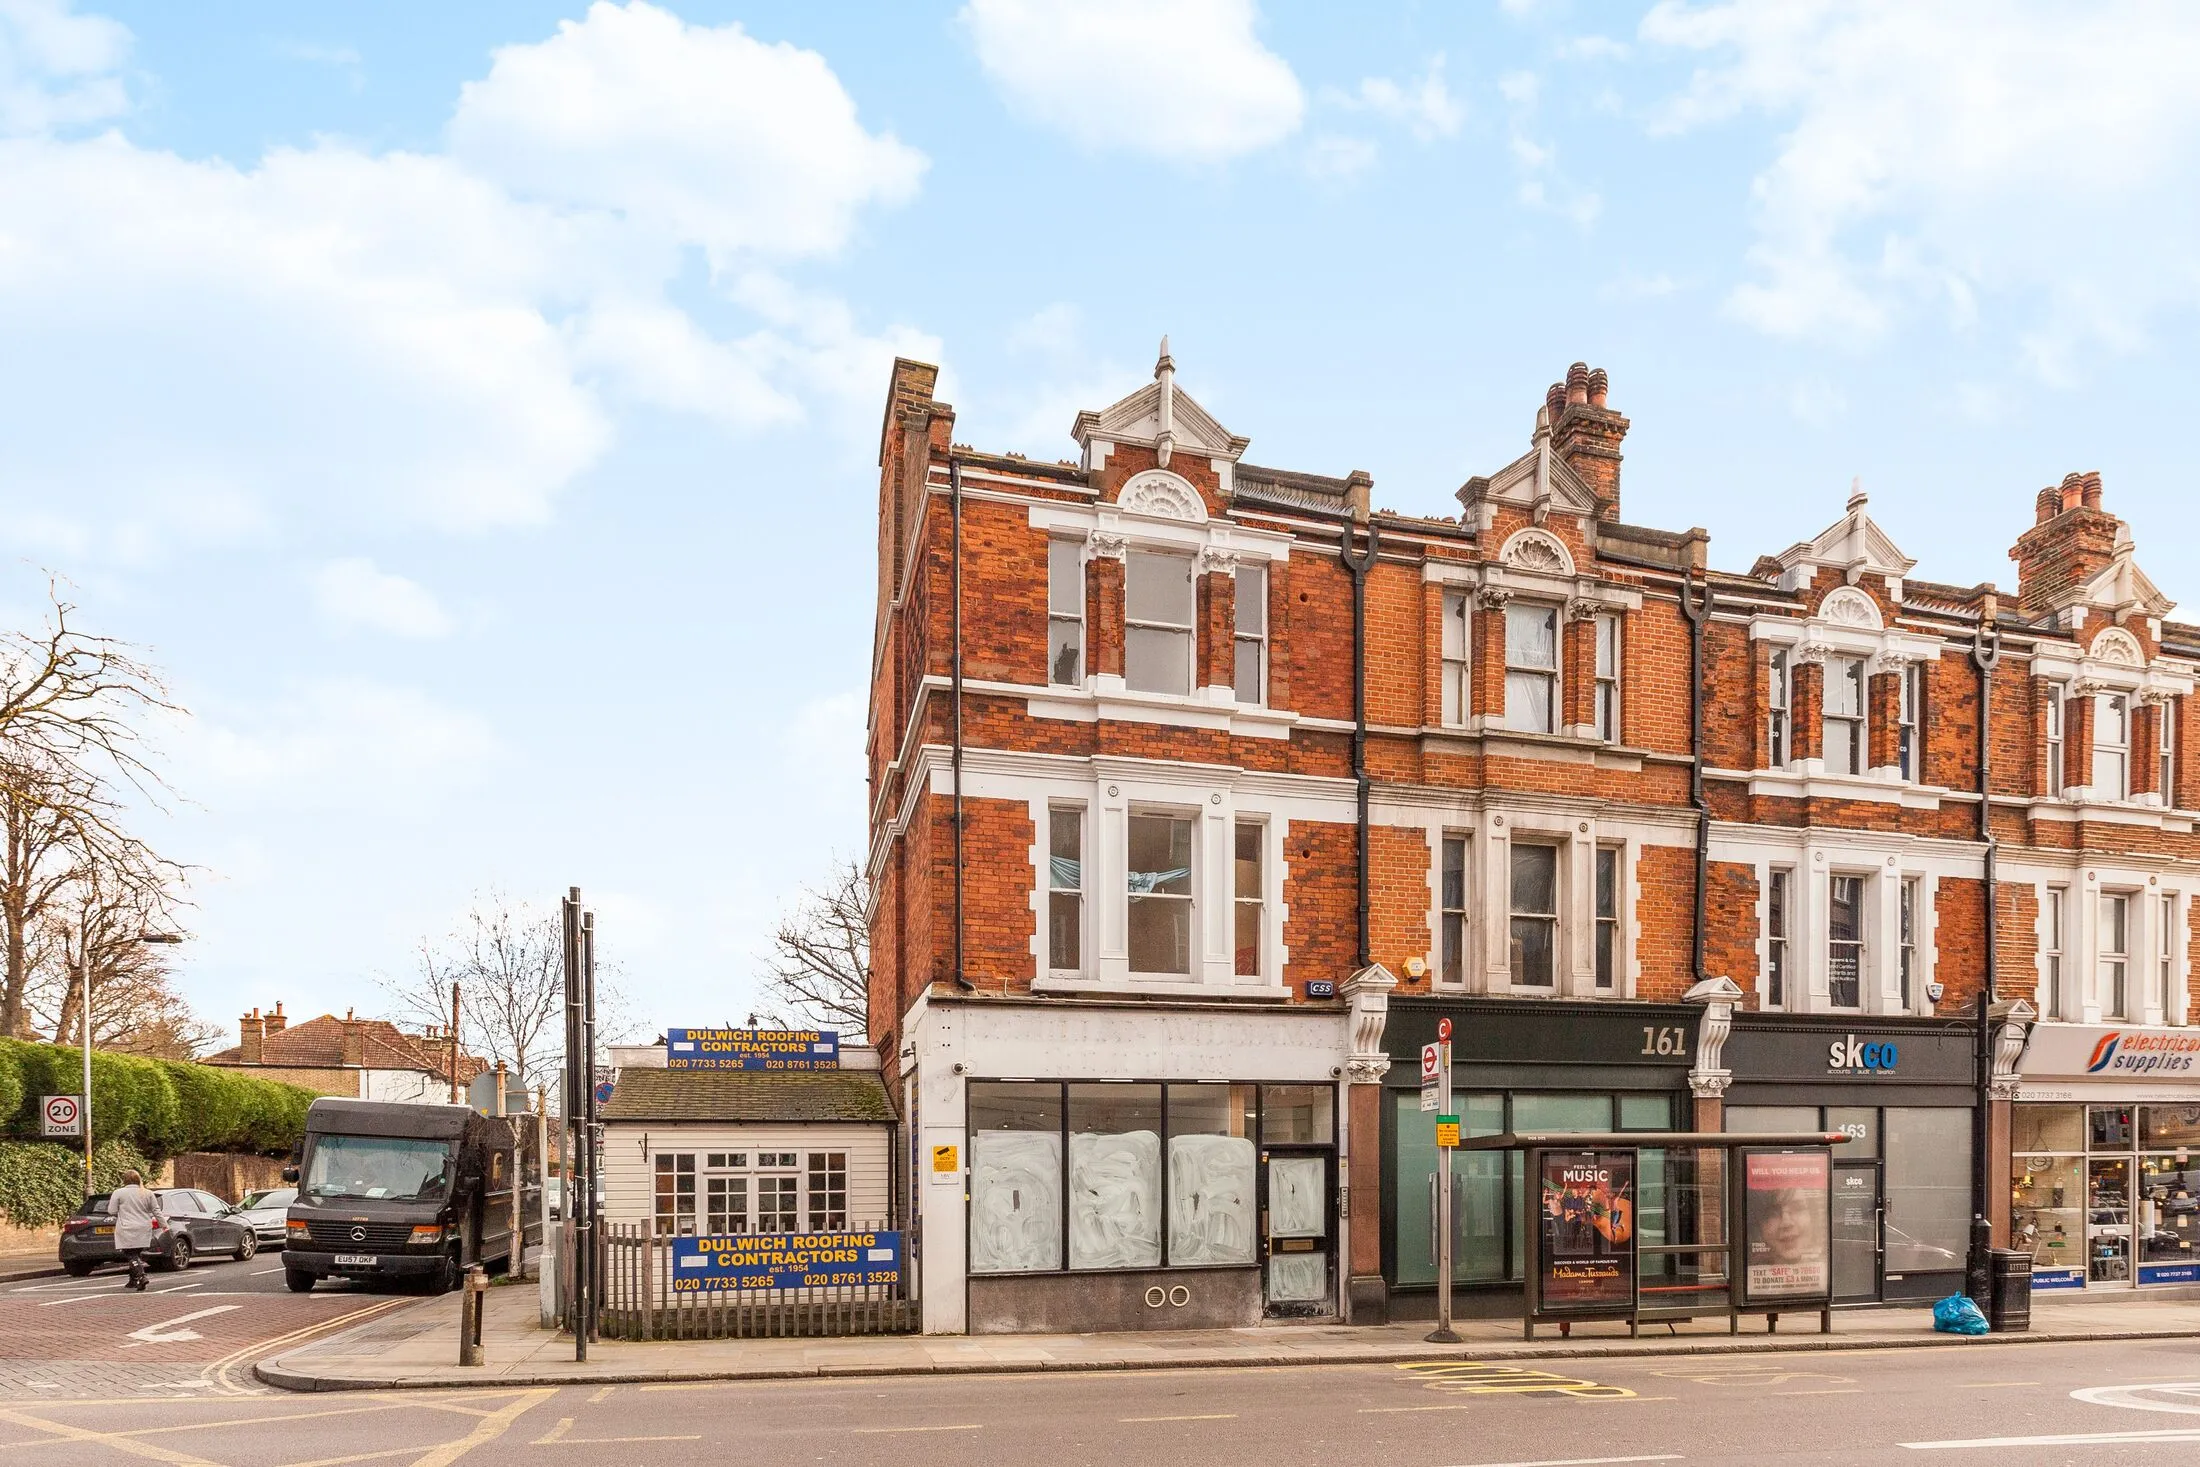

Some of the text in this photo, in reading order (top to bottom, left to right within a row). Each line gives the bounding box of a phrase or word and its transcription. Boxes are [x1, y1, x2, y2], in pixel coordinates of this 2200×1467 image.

[1312, 984, 1331, 992] CSS
[687, 1030, 820, 1041] DULWICH ROOFING
[1440, 1023, 1446, 1038] C
[701, 1042, 807, 1053] CONTRACTORS
[1641, 1027, 1686, 1055] 161
[2123, 1032, 2200, 1051] electrica
[1829, 1034, 1898, 1069] skco
[669, 1059, 837, 1069] 020 7733 5265 020 8761 3528
[2115, 1053, 2192, 1073] supplies
[52, 1105, 73, 1116] 20
[1838, 1124, 1866, 1138] 163
[1563, 1170, 1608, 1182] MUSIC
[1846, 1176, 1863, 1185] skco
[699, 1234, 875, 1252] DULWICH ROOFING
[718, 1250, 858, 1266] CONTRACTORS
[788, 1264, 809, 1272] 1954
[1553, 1266, 1619, 1278] Madame Tussauds
[675, 1271, 898, 1290] 020 7733 5265 020 8761 3528
